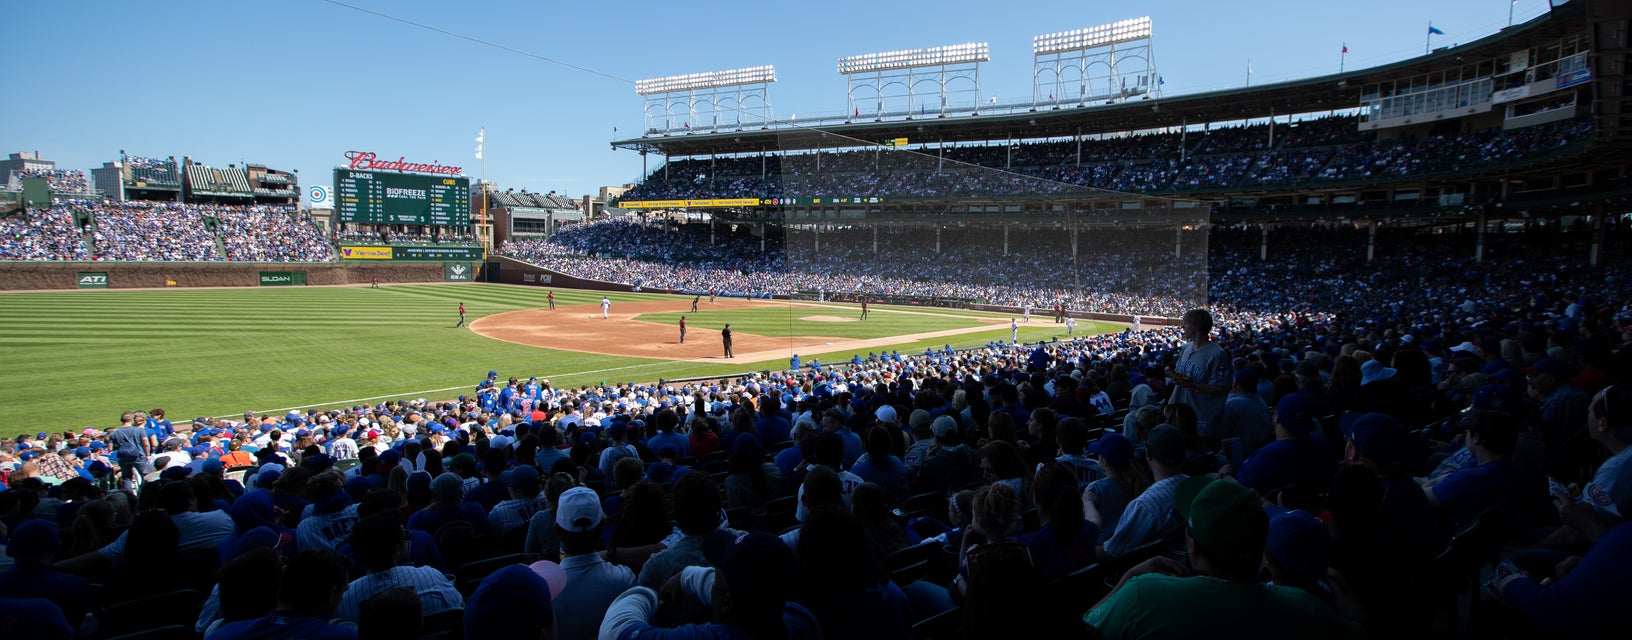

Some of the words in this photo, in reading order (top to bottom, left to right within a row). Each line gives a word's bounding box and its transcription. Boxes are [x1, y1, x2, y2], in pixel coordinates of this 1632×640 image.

[344, 150, 462, 176] Budweiser
[349, 172, 374, 180] D-BACKS
[442, 178, 456, 186] CUBS
[386, 187, 427, 197] BIOFREEZE
[80, 275, 107, 283] ATI
[1095, 396, 1110, 409] 44
[337, 449, 348, 459] 17
